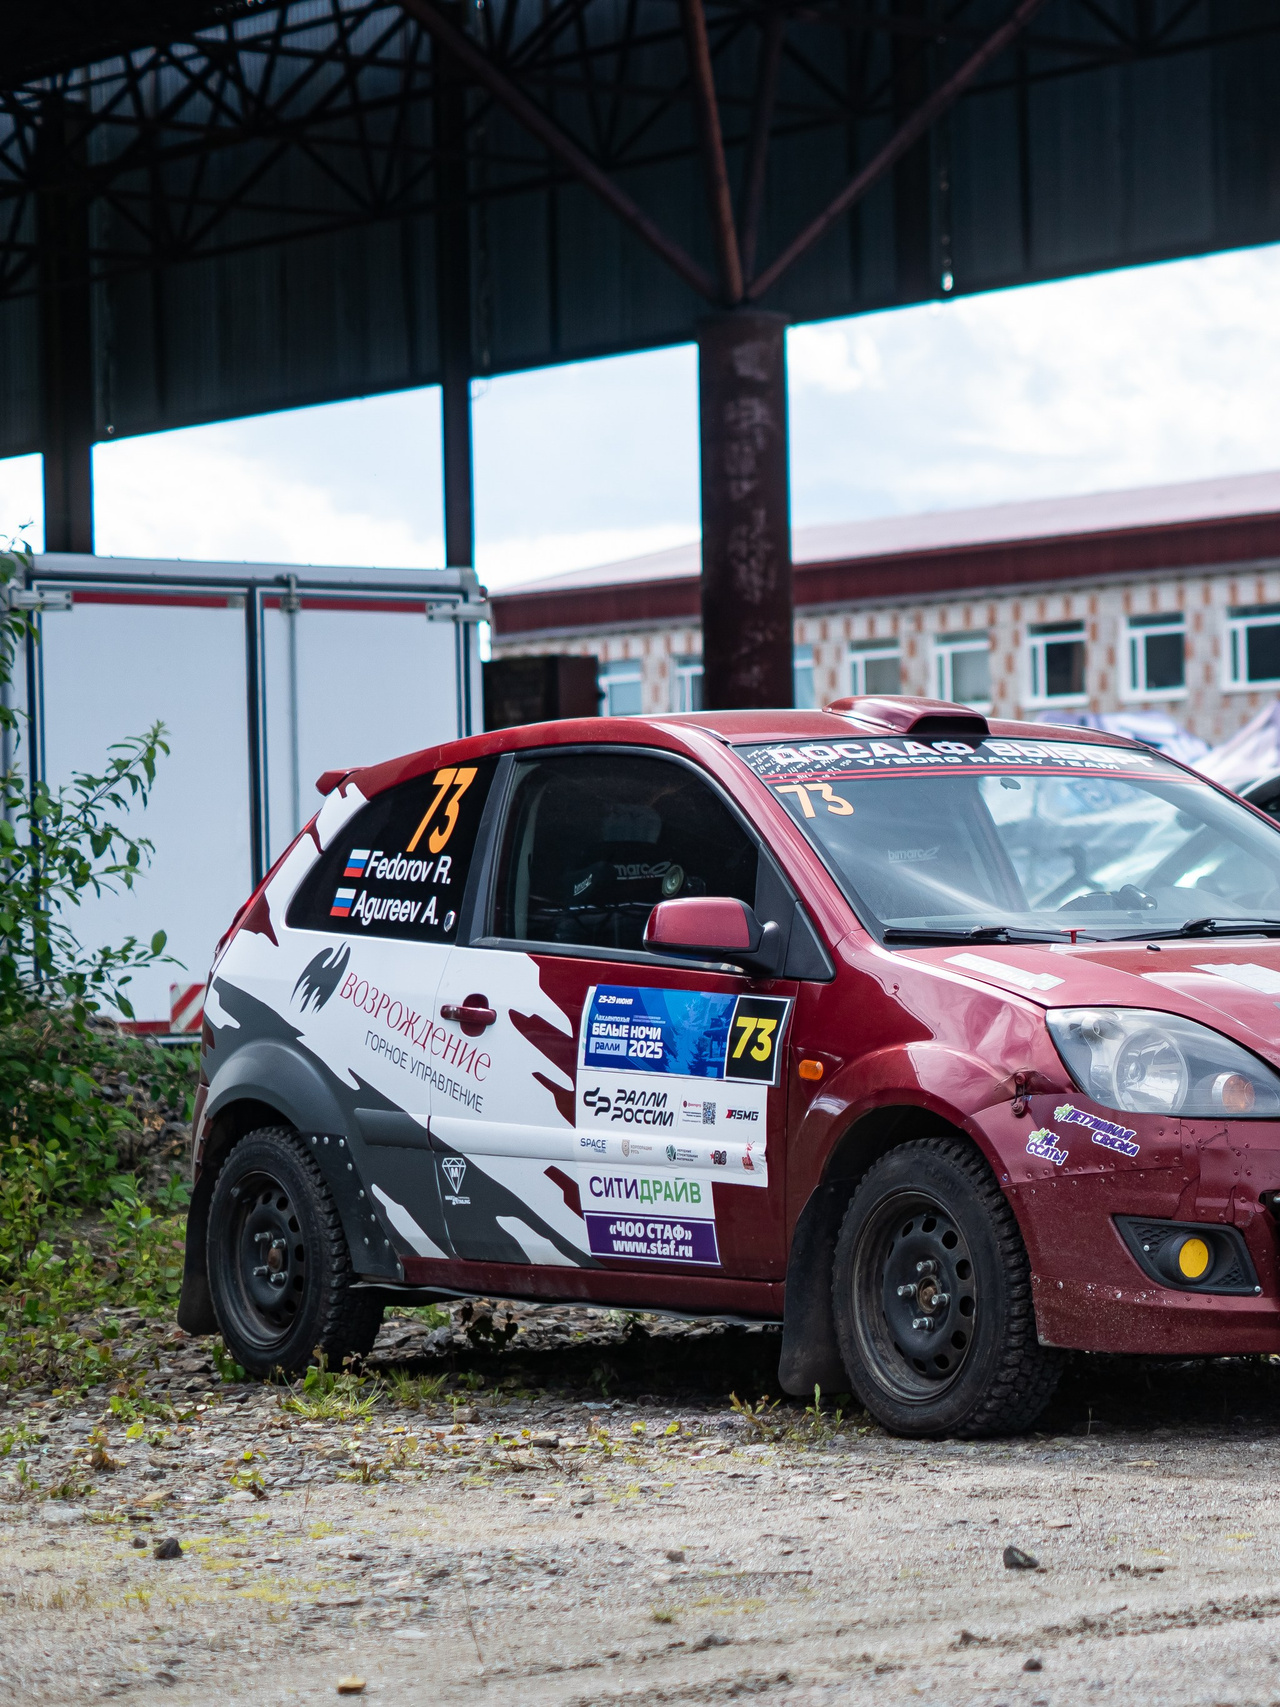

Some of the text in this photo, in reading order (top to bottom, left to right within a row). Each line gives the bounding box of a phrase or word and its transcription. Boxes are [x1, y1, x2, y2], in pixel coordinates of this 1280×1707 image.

[766, 741, 976, 767] ДОСААФ
[982, 742, 1154, 768] ВЫБОРГ
[857, 756, 1121, 771] VYBORG RALLY TEAM
[406, 767, 478, 854] 73
[774, 783, 854, 818] 73
[365, 851, 452, 884] Fedorov R.
[351, 890, 439, 926] Agureev A.
[592, 1022, 662, 1040] БЕЛЫЕ НОЧИ
[732, 1016, 777, 1062] 73
[595, 1042, 620, 1053] ралли
[628, 1040, 664, 1059] 2025
[365, 1030, 484, 1114] ГОРНОЕ УПРАВЛЕНИЕ
[615, 1088, 668, 1108] РАЛЛИ
[611, 1107, 674, 1127] РОССИИ
[580, 1138, 606, 1149] SPACE
[1026, 1142, 1068, 1165] ССАТЬ!
[589, 1176, 702, 1204] СИТИДРАЙВ
[609, 1221, 692, 1241] «ЧОО СТАФ»
[612, 1239, 693, 1258] www.staf.ru
